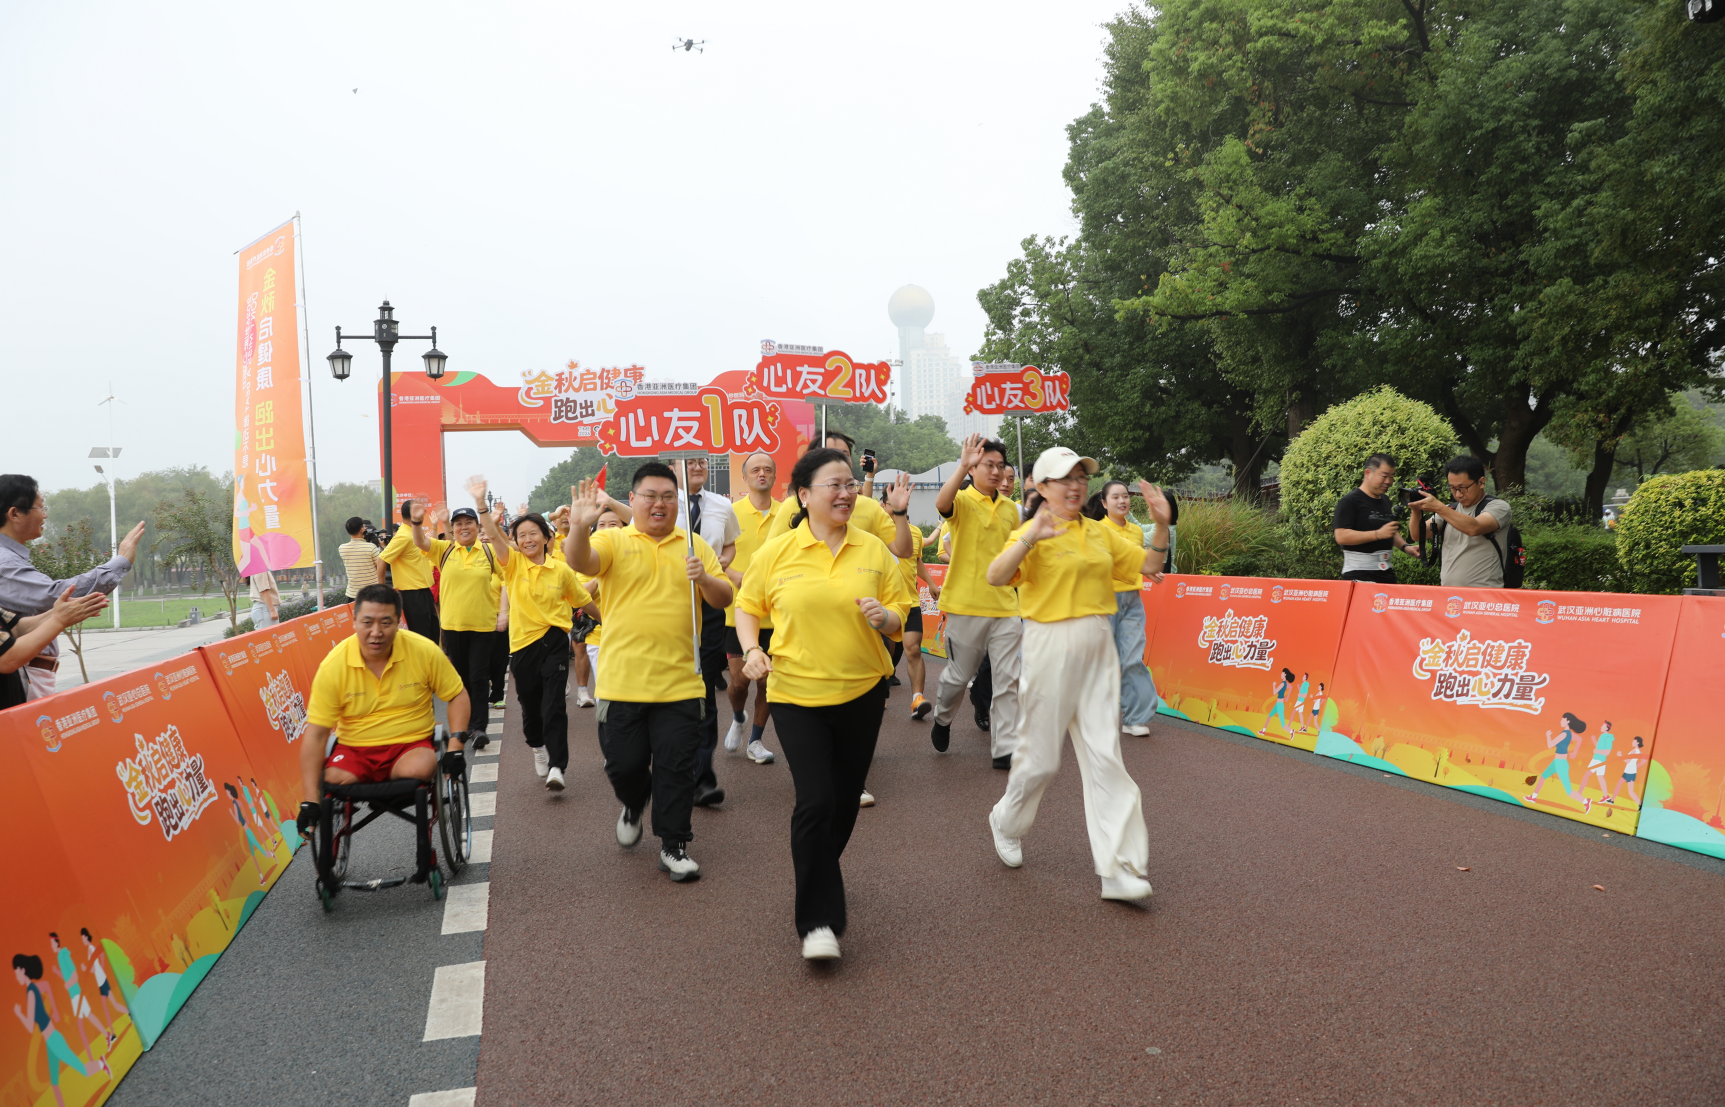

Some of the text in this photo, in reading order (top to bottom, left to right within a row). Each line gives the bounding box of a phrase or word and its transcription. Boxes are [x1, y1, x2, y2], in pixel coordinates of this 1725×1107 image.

[524, 364, 645, 396] 金秋启健康
[637, 383, 698, 391] 香港亚洲医疗集团
[762, 355, 884, 398] 心友2队
[976, 371, 1067, 409] 心友3队
[619, 394, 771, 448] 心友1队
[1388, 598, 1433, 607] 香港亚洲医疗集团
[1463, 601, 1520, 613] 武汉亚心总医院
[1557, 605, 1642, 618] 武汉亚洲心脏病医院
[1204, 616, 1267, 639] 金秋启健康
[1209, 640, 1276, 661] 跑出心力量
[1421, 640, 1530, 671] 金秋启健康
[1433, 672, 1547, 701] 跑出心力量
[124, 724, 189, 806] 金秋启健康
[153, 753, 209, 839] 跑出心力量
